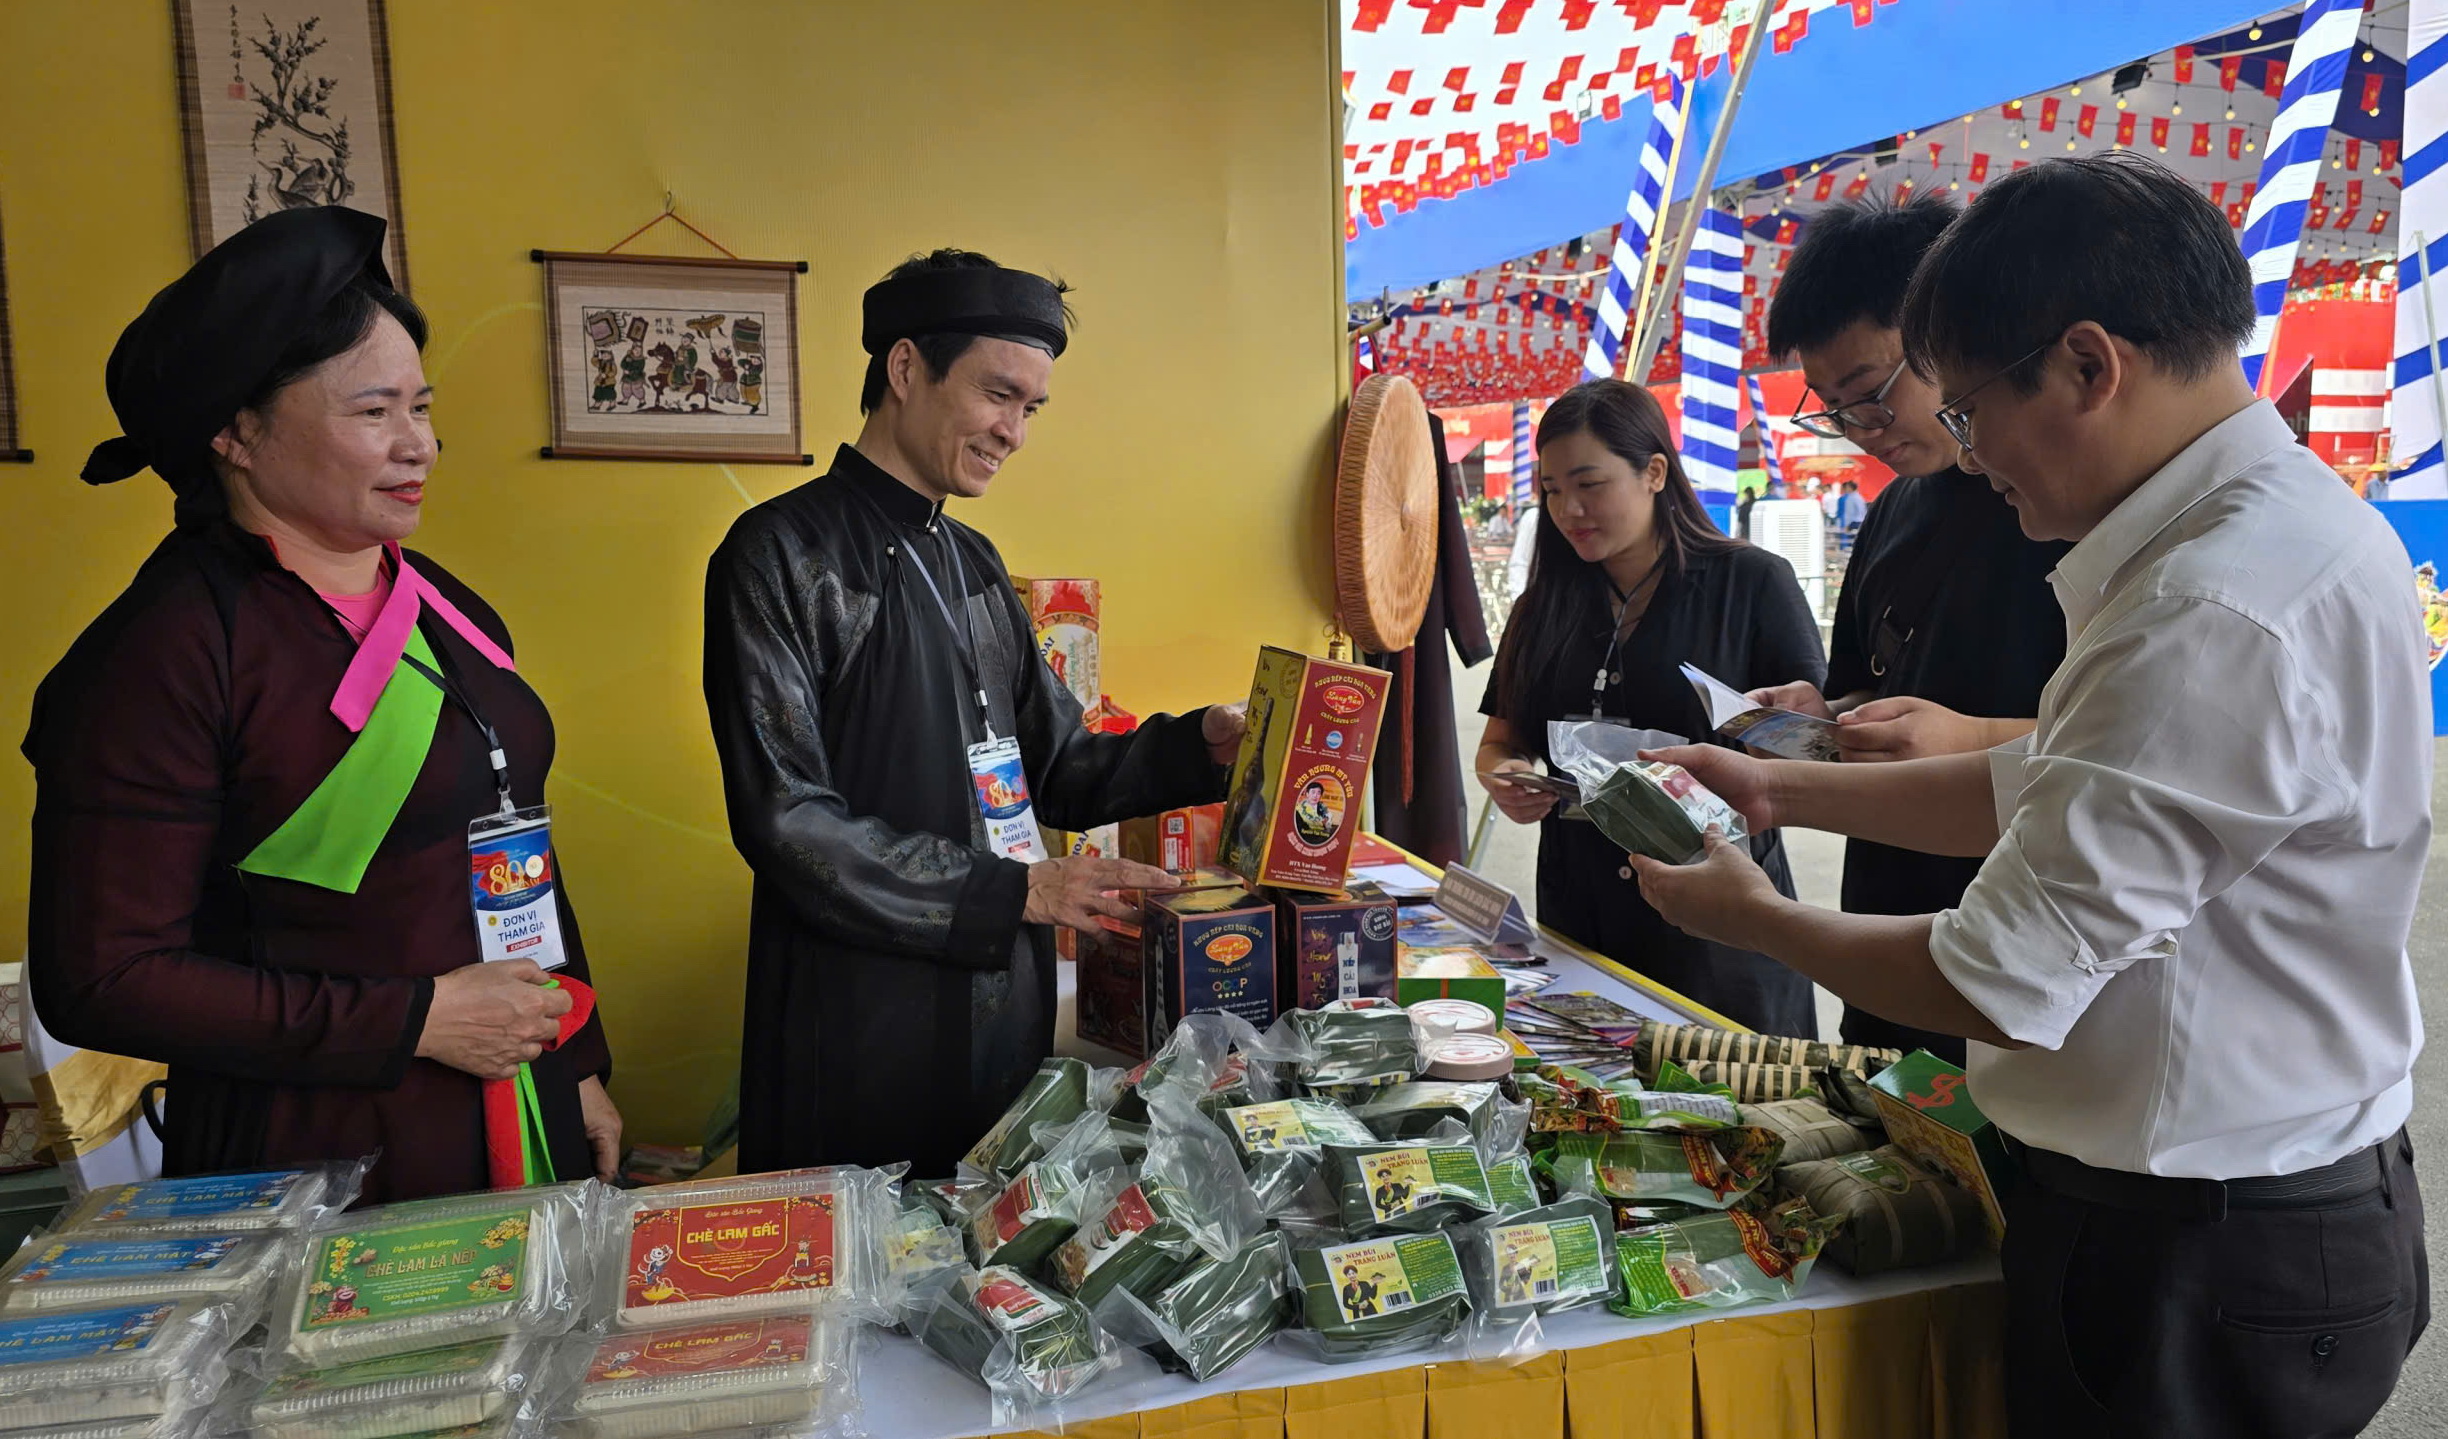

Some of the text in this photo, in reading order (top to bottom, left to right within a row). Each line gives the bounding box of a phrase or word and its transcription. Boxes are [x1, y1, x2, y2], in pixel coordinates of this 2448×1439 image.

[1001, 830, 1031, 845] THAM GIA
[489, 859, 525, 896] 80
[503, 910, 537, 928] ĐƠN VỊ
[497, 921, 546, 943] THAM GIA
[1212, 977, 1248, 991] OCOP
[687, 1220, 780, 1244] CHÈ LAM GẤC
[366, 1247, 478, 1278] CHÈ LAM LÁ NẾP
[1345, 1252, 1362, 1260] NEM
[1353, 1256, 1377, 1266] TRANG
[654, 1331, 754, 1350] CHÈ LAM GẤC
